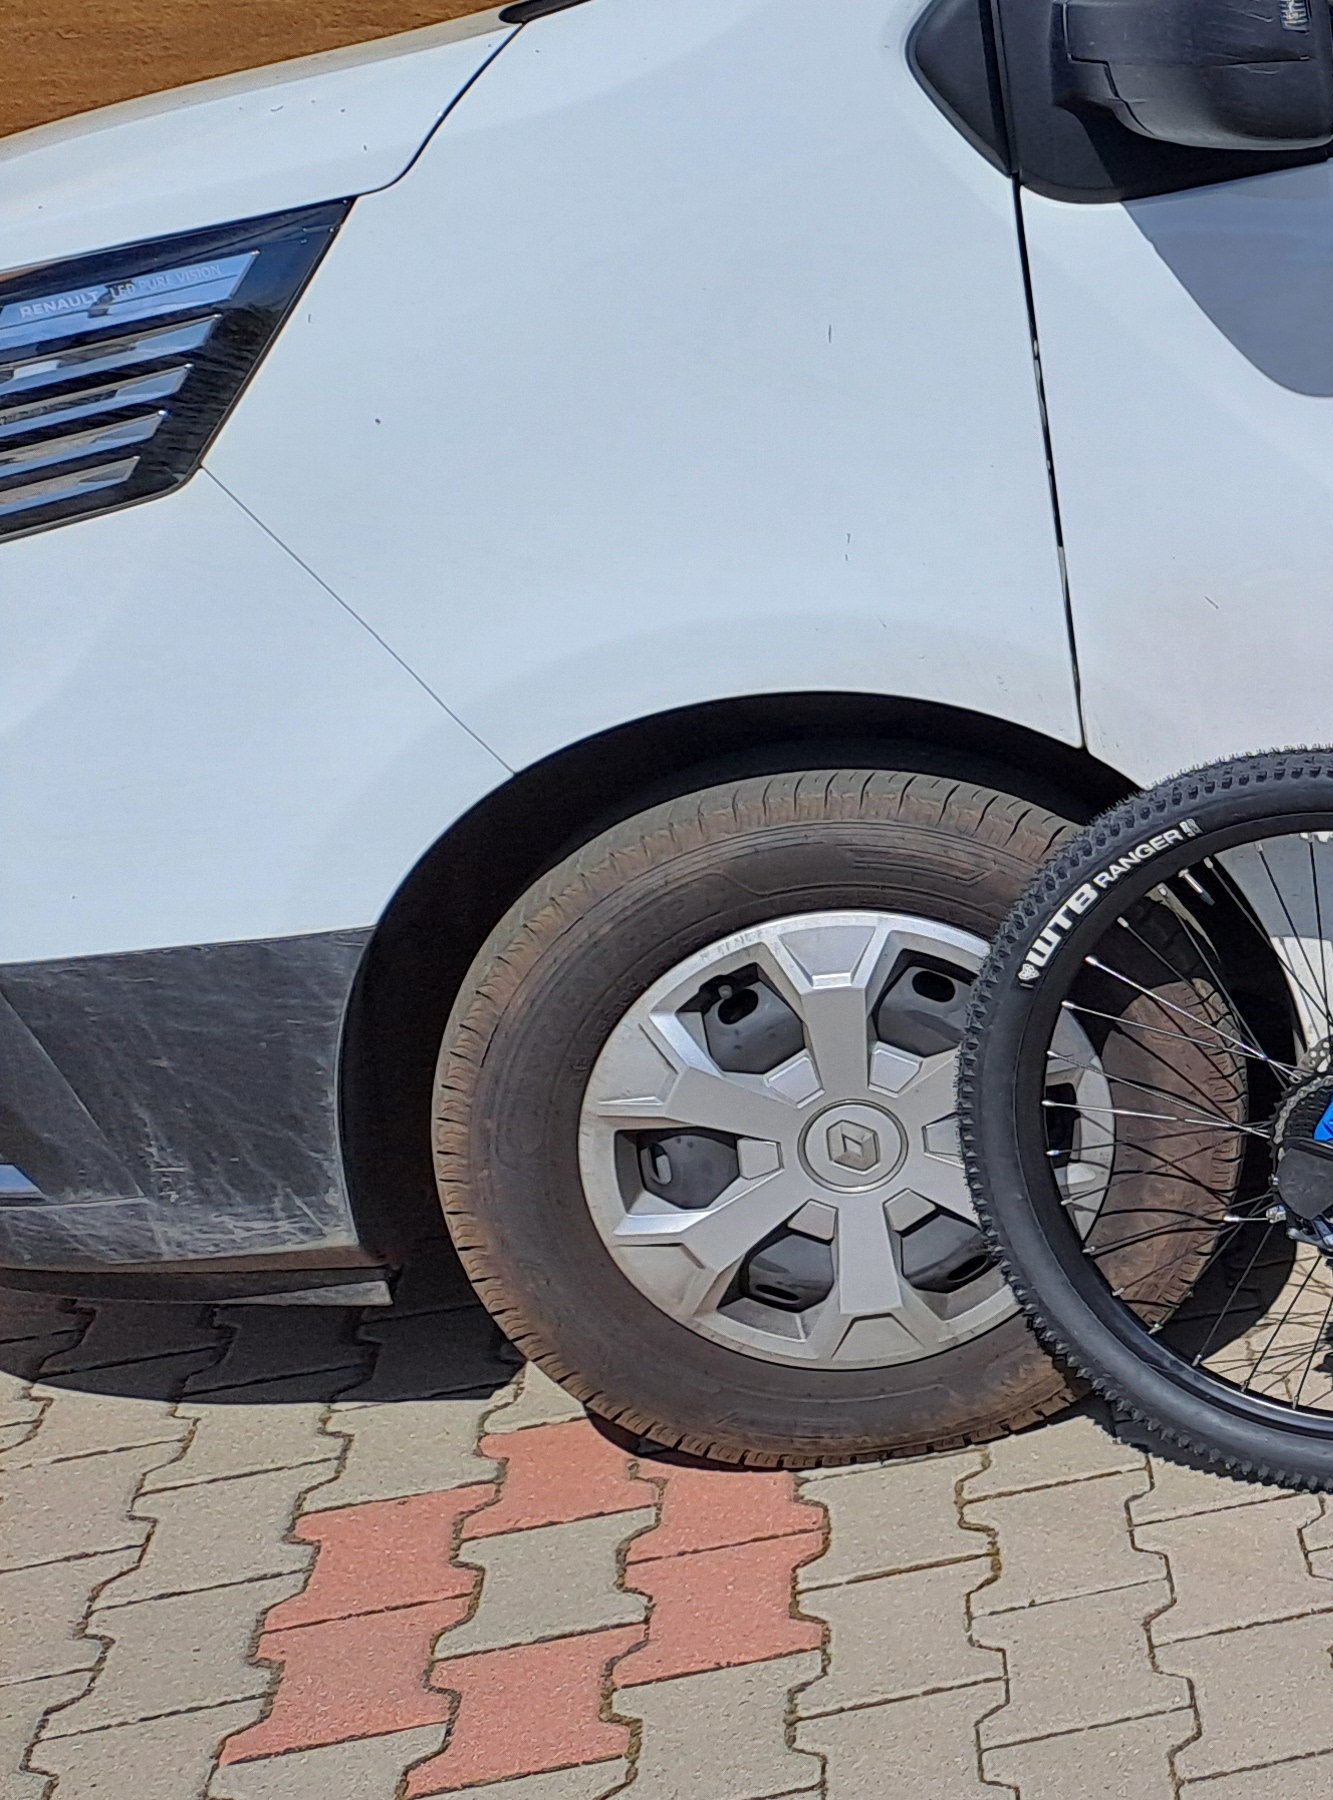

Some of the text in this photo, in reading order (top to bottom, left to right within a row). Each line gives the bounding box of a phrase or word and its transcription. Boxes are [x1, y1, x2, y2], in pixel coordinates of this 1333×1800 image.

[20, 265, 222, 318] RENAULT LED PURE VISION
[1026, 829, 1184, 967] WTB RANGER
